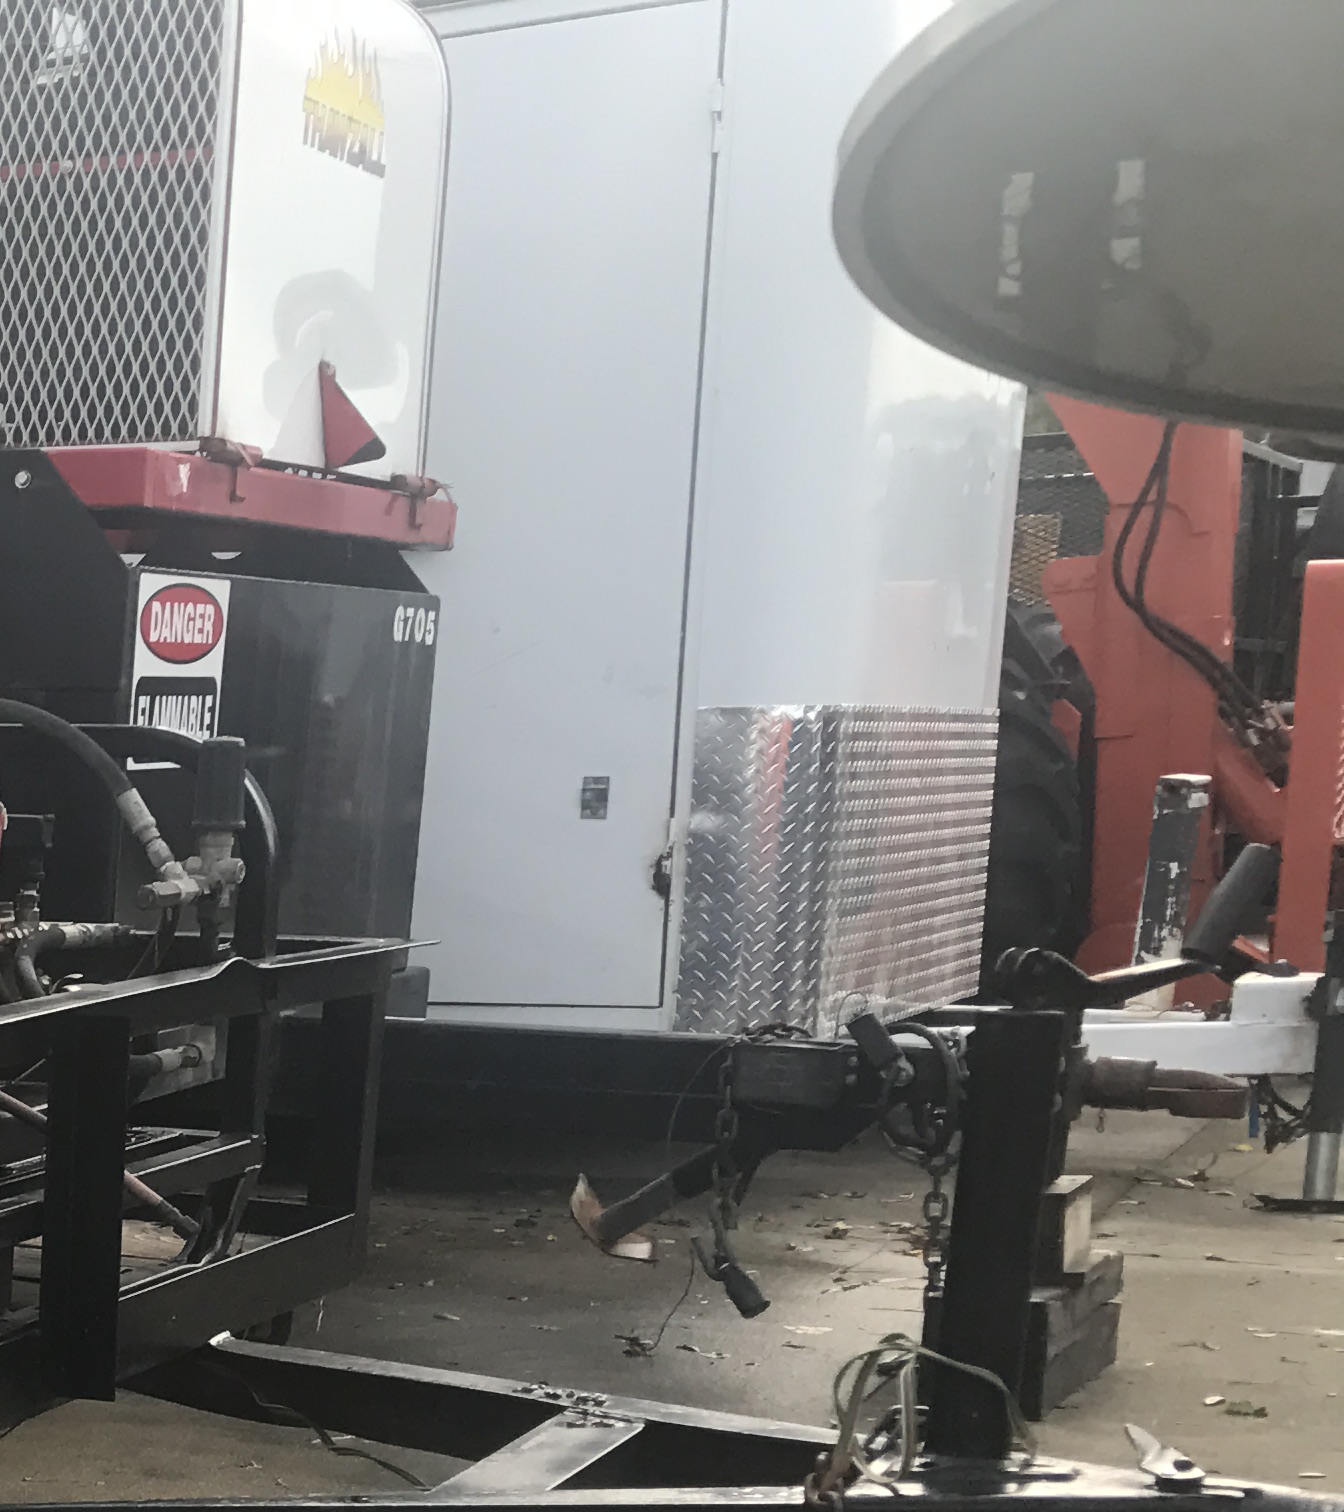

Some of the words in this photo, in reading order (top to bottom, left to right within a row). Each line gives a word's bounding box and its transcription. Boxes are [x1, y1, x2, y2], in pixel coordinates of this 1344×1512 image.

[149, 601, 216, 645] DANGER
[393, 605, 436, 646] G705
[137, 695, 214, 739] FLAMMABLE
